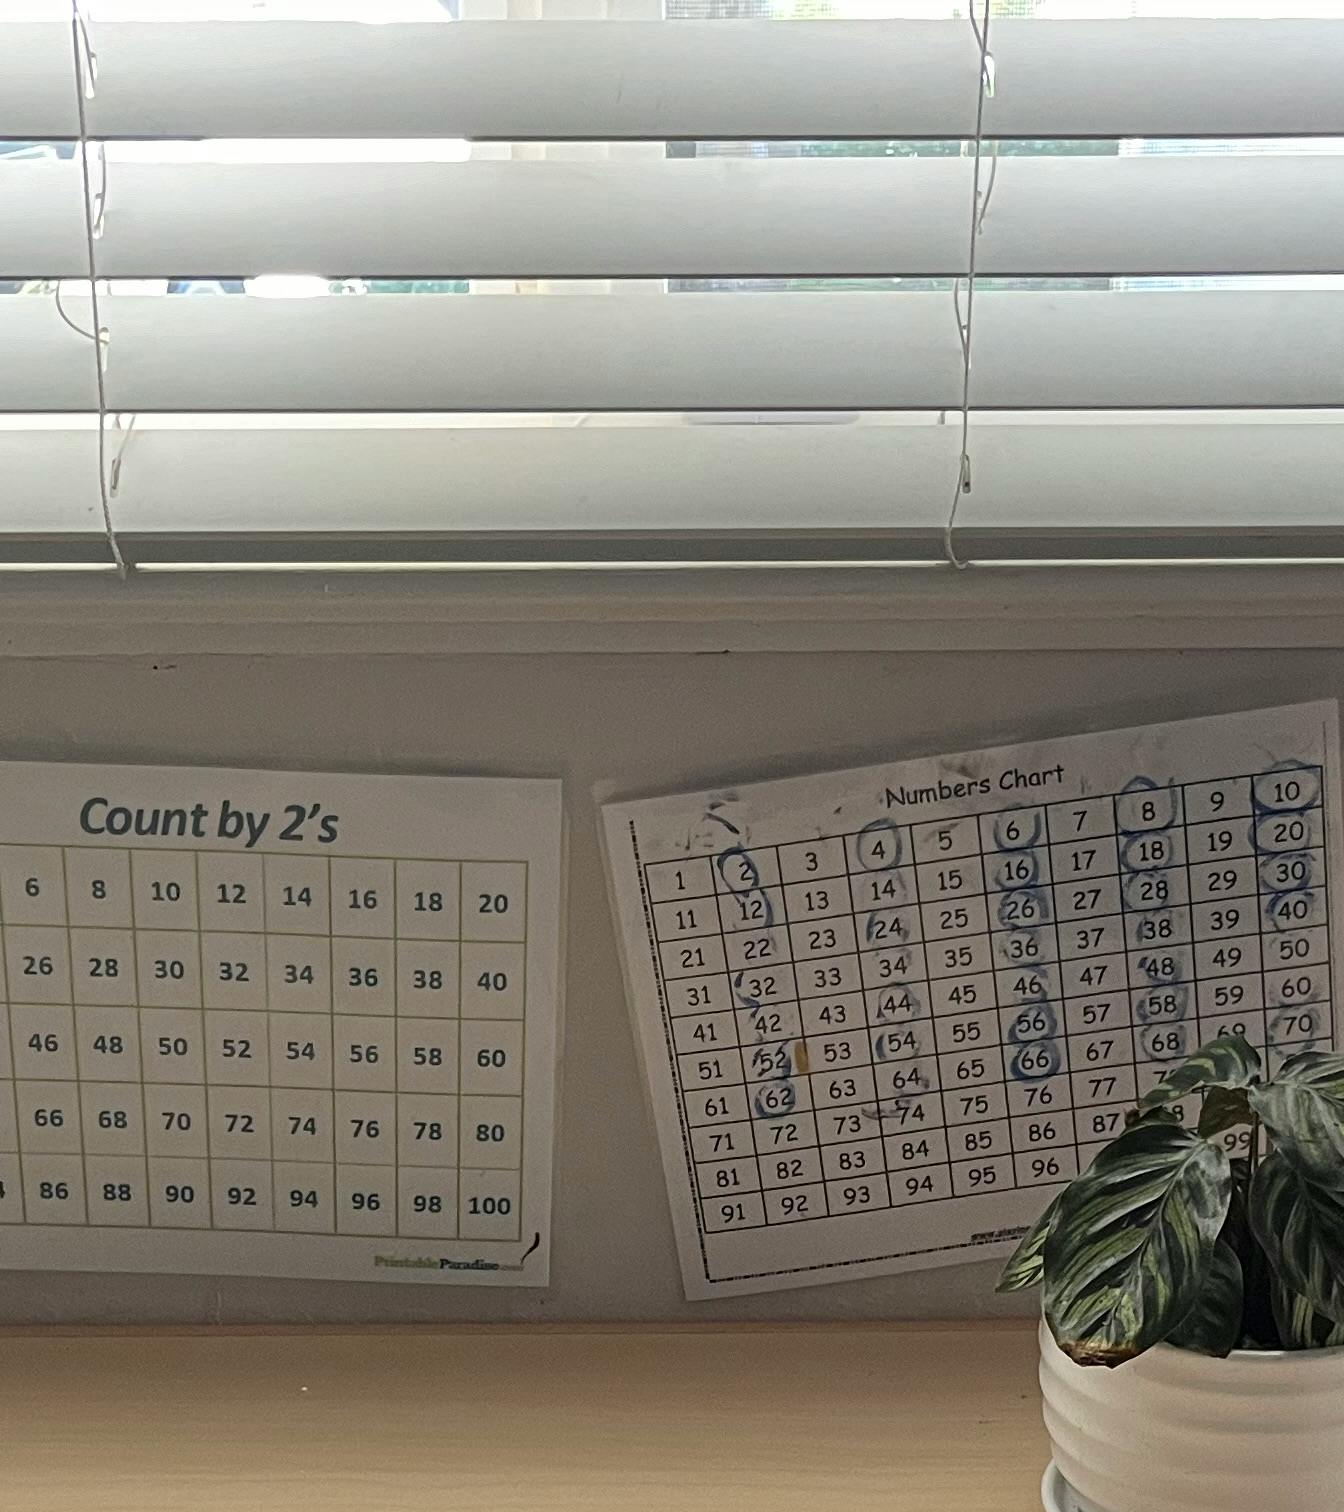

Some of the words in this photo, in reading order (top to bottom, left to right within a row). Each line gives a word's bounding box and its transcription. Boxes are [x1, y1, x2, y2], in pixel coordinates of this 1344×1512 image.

[885, 778, 991, 808] Numbers
[999, 765, 1064, 790] Chart
[80, 797, 208, 837] Count
[218, 800, 270, 848] by
[279, 803, 339, 843] 2's
[676, 871, 685, 890] 1
[740, 861, 755, 882] 2
[805, 852, 818, 871] 3
[871, 840, 885, 859] 4
[939, 829, 952, 849] 5
[1006, 821, 1020, 840] 6
[1073, 810, 1087, 831] 7
[1142, 801, 1156, 821] 8
[1210, 791, 1224, 812] 9
[1275, 781, 1300, 803] 10
[25, 878, 39, 897] 6
[92, 880, 106, 899] 8
[152, 882, 180, 901] 10
[218, 884, 246, 903] 12
[284, 886, 311, 906] 14
[349, 889, 377, 909] 16
[415, 892, 442, 911] 18
[479, 894, 508, 913] 20
[24, 956, 53, 975] 26
[89, 958, 118, 977] 28
[155, 960, 184, 979] 30
[220, 962, 249, 981] 32
[285, 964, 314, 984] 34
[349, 967, 378, 987] 36
[414, 970, 442, 989] 38
[477, 972, 507, 991] 40
[40, 1182, 68, 1199] 86
[103, 1184, 131, 1201] 88
[166, 1185, 194, 1203] 90
[228, 1187, 256, 1205] 92
[290, 1190, 318, 1207] 94
[352, 1193, 380, 1211] 96
[414, 1195, 442, 1213] 98
[469, 1197, 511, 1215] 100
[721, 1203, 745, 1223] 91
[781, 1195, 808, 1215] 92
[843, 1186, 870, 1205] 93
[906, 1175, 933, 1196] 94
[968, 1166, 996, 1187] 95
[1032, 1157, 1059, 1177] 96
